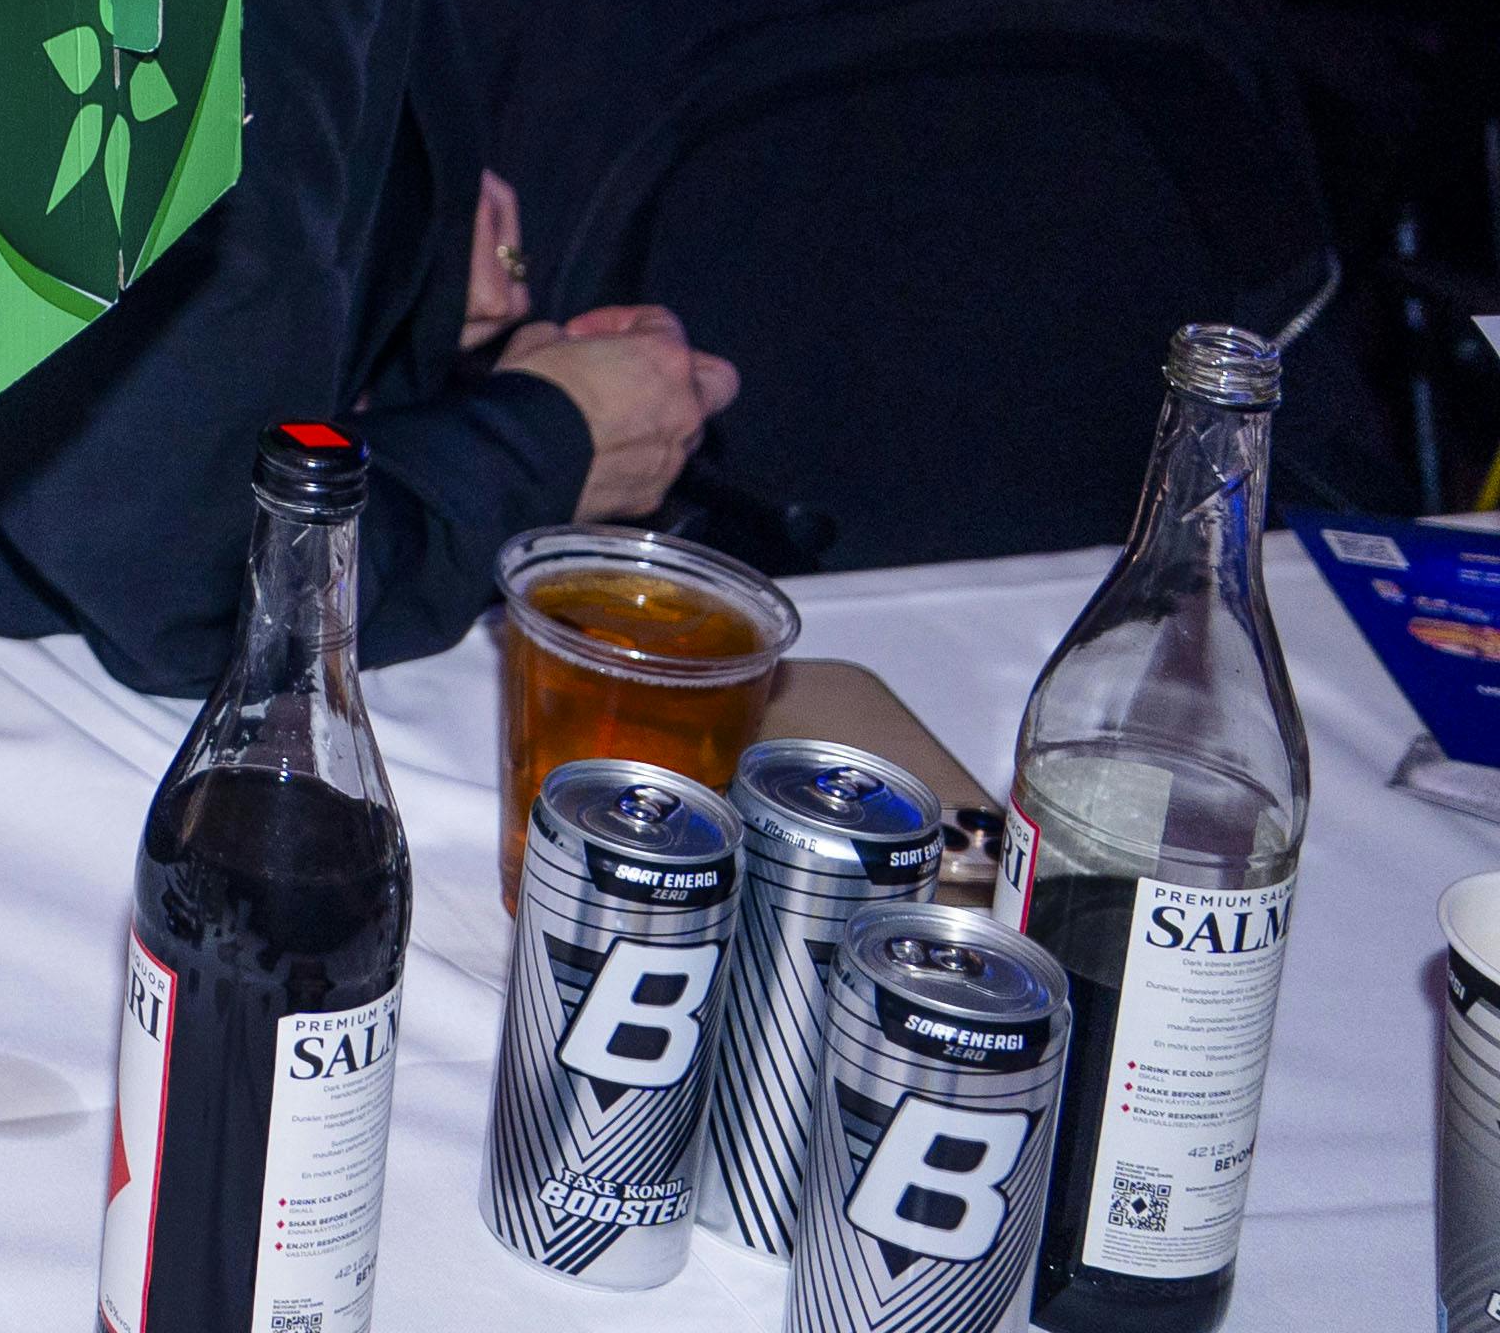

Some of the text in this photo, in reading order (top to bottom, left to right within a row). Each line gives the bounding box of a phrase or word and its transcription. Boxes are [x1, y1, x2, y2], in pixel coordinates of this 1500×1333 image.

[763, 818, 806, 851] Vitamin
[889, 851, 923, 867] SORT
[664, 870, 718, 888] ENERGI
[651, 888, 689, 901] ZERO
[1155, 887, 1252, 908] PREMIUM
[130, 945, 166, 995] IQUOR
[295, 1007, 378, 1032] PREMIUM
[559, 941, 720, 1088] B
[957, 1030, 1024, 1050] ENERGI
[943, 1044, 988, 1061] ZERO
[1139, 1064, 1214, 1077] DRINK ICE COLD
[1137, 1084, 1169, 1096] SHAKE
[1171, 1090, 1207, 1098] BEFORE
[1133, 1107, 1224, 1120] ENJOY RESPONSIBLY
[562, 1169, 683, 1199] FAXE KONDI
[847, 1095, 1032, 1263] B
[289, 1188, 354, 1206] DRINK ICE COLD
[539, 1178, 692, 1226] BOOSTER
[288, 1219, 317, 1228] SHAKE
[318, 1211, 348, 1225] BEFORE
[286, 1242, 315, 1250] ENJOY
